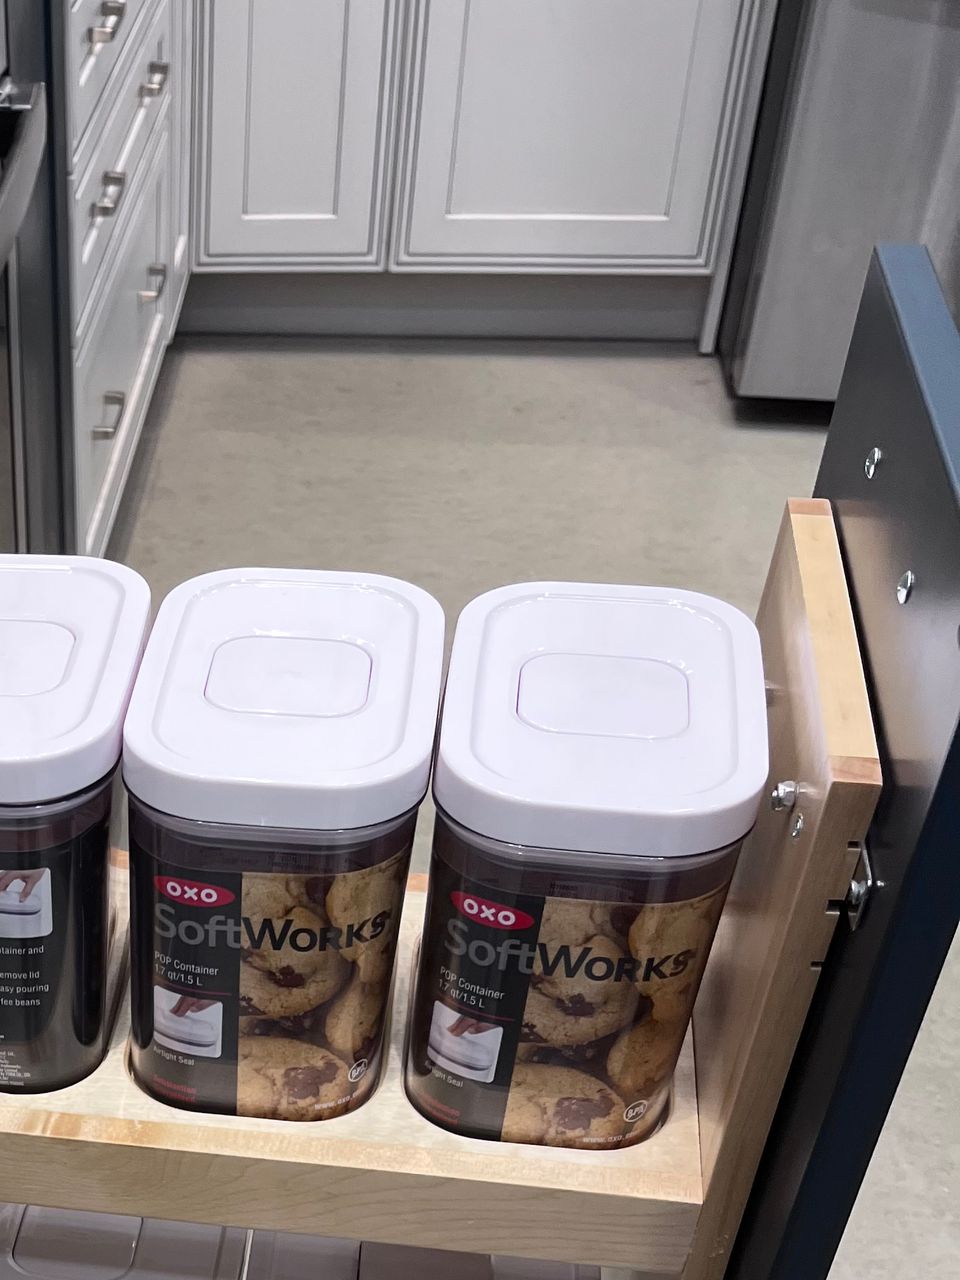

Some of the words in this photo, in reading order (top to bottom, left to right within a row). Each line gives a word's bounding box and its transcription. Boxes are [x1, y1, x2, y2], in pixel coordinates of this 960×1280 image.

[27, 944, 44, 955] and
[154, 950, 172, 966] POP
[173, 958, 220, 976] Container
[29, 970, 40, 979] lid
[153, 963, 166, 976] 1.7
[167, 970, 195, 986] qt/1.5
[196, 975, 204, 986] L
[16, 984, 49, 994] pouring
[440, 965, 457, 982] POP
[458, 977, 506, 1001] Container
[14, 998, 41, 1006] beans
[451, 988, 477, 1006] qt/1.5
[478, 998, 486, 1009] L
